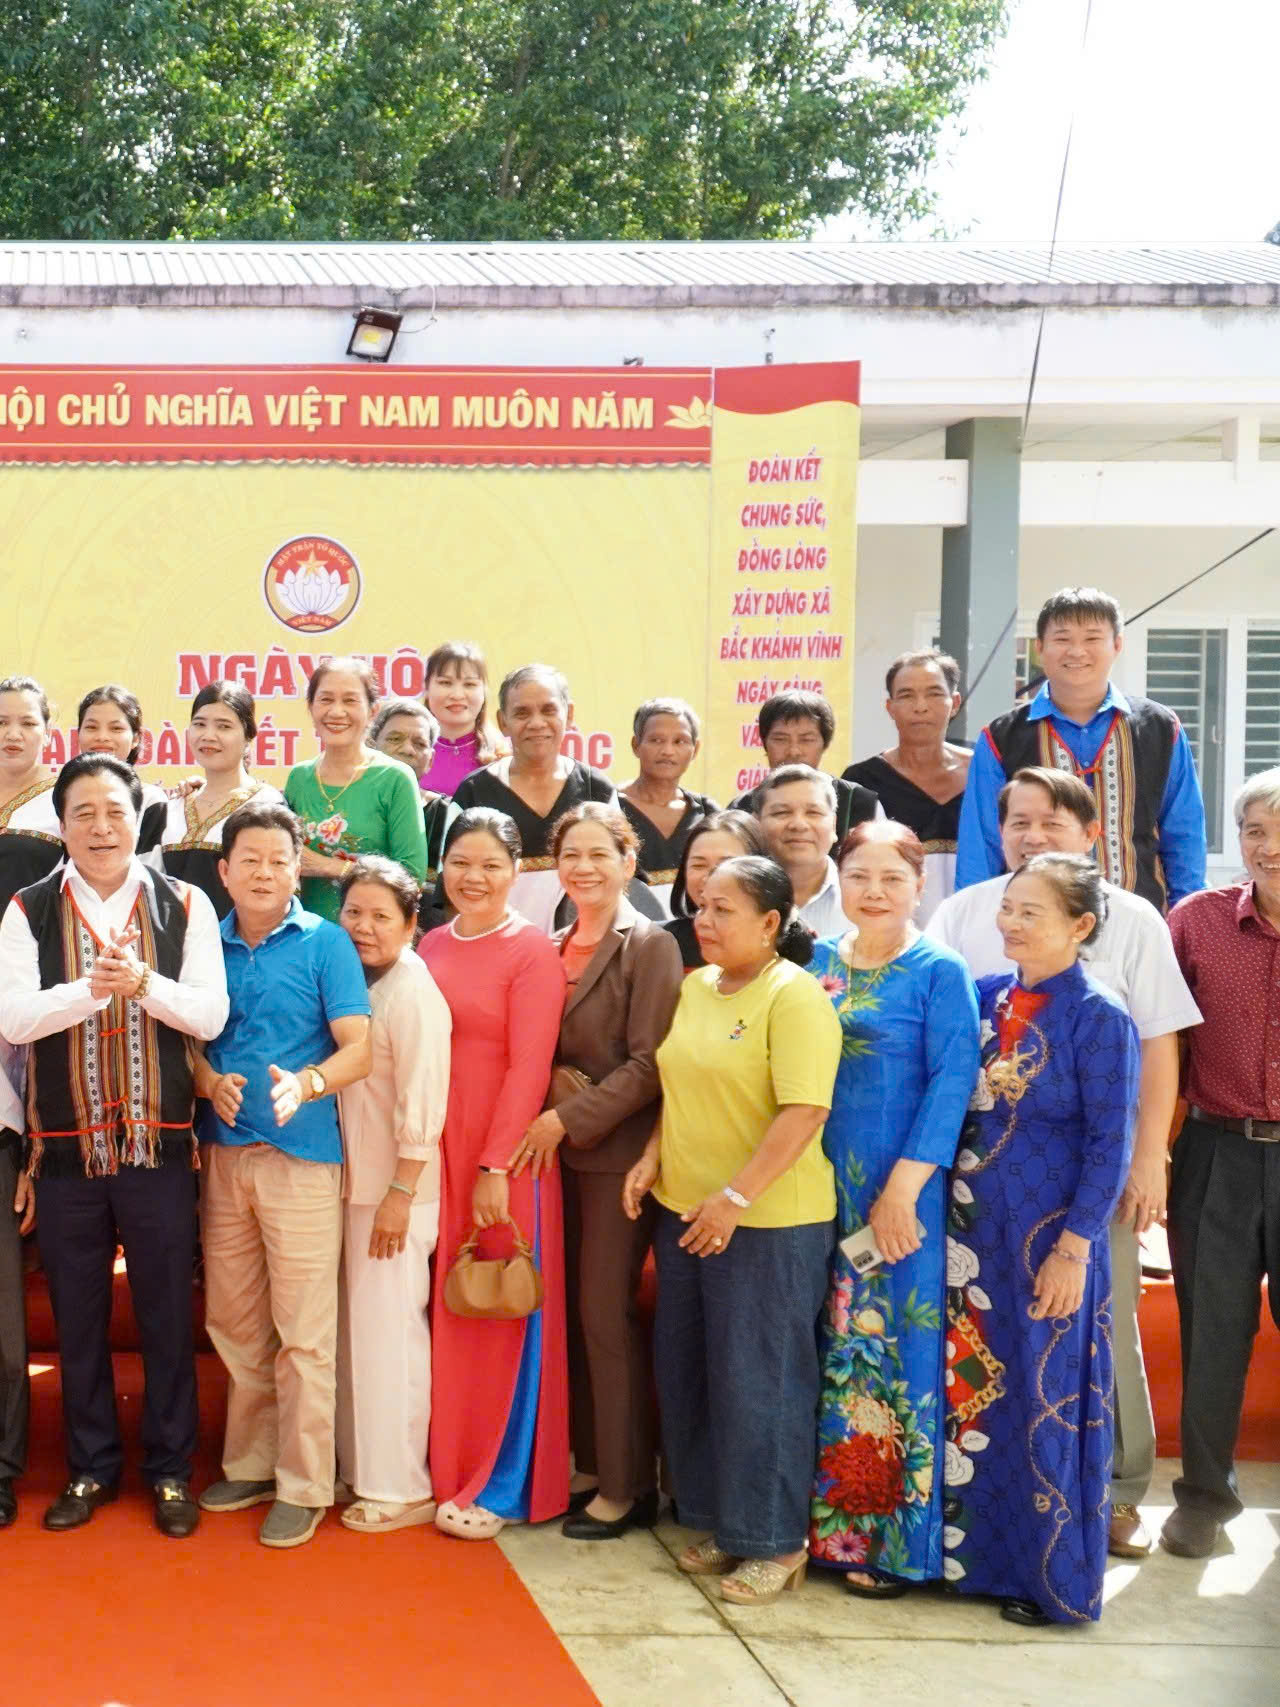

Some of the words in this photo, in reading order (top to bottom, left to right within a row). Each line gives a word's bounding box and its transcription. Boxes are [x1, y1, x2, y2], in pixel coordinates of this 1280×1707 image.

[57, 382, 131, 426] CHỦ
[145, 386, 254, 426] NGHĨA
[264, 386, 347, 432] VIỆT
[360, 395, 440, 428] NAM
[453, 388, 559, 428] MUÔN
[572, 391, 654, 429] NĂM
[748, 453, 792, 483] ĐOÀN
[794, 447, 822, 481] KẾT
[741, 503, 792, 528] CHUNG
[738, 538, 782, 572] ĐỒNG
[785, 541, 827, 571] LÒNG
[732, 587, 762, 616] XÂY
[764, 588, 807, 622] DỰNG
[810, 585, 831, 614] XÃ
[720, 624, 748, 660] BẮC
[751, 629, 803, 660] KHÁNH
[807, 631, 842, 659] VĨNH
[736, 675, 778, 703] NGÀY
[42, 729, 80, 772] ẠI
[244, 715, 300, 766] ẾT
